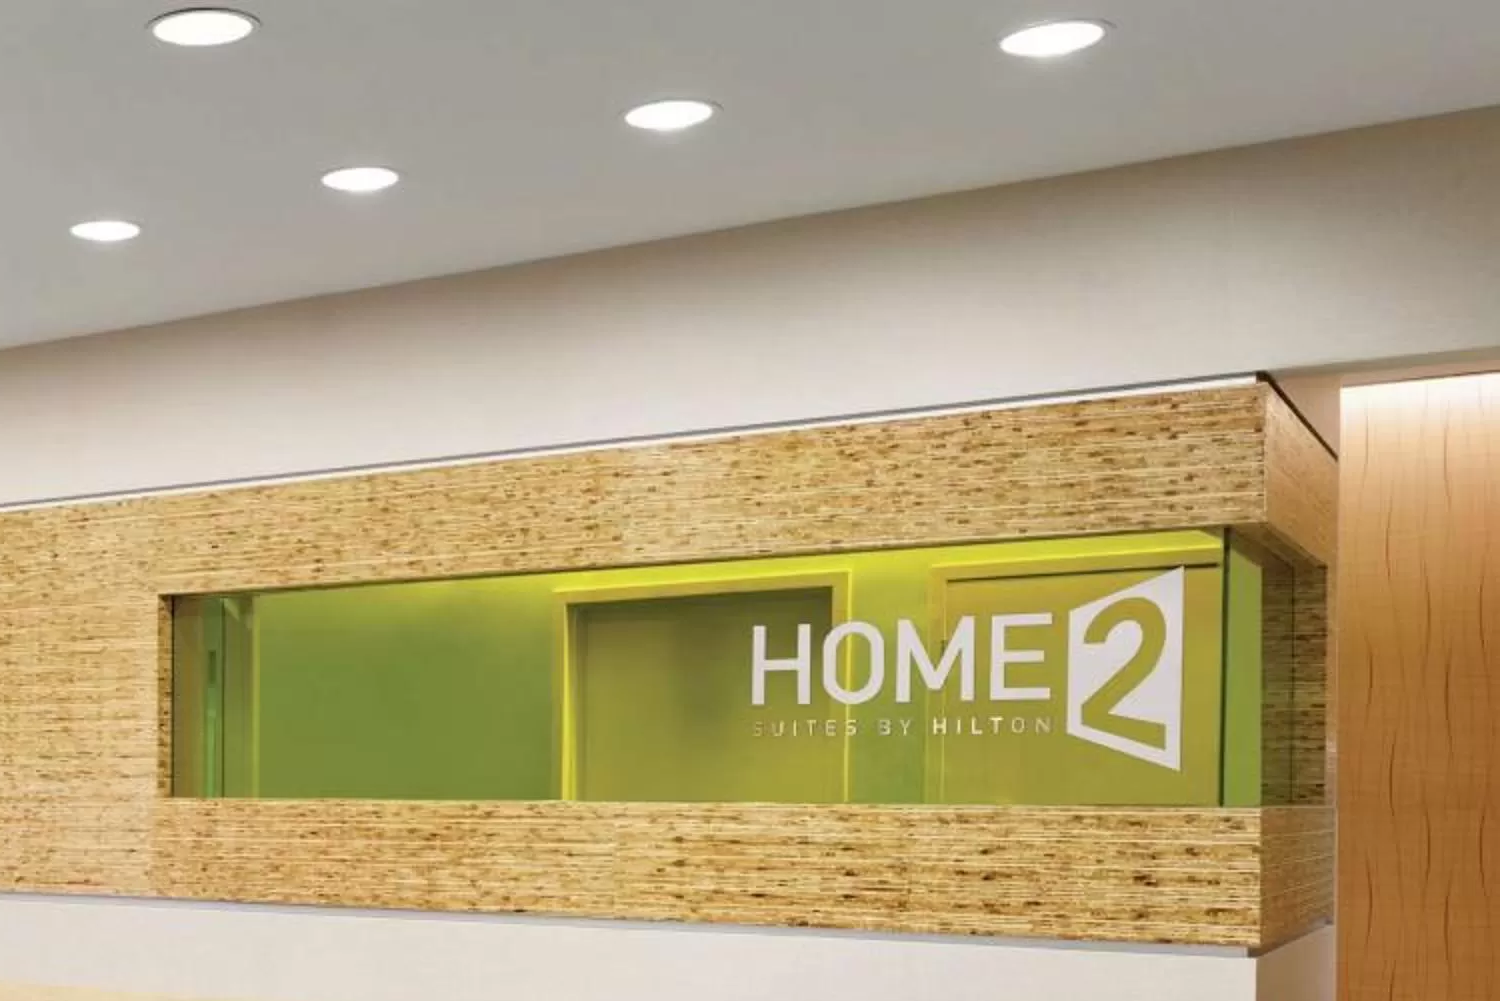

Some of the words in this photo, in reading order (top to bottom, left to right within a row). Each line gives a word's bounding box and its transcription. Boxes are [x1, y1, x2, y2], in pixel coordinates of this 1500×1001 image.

[752, 719, 857, 737] SUITES
[879, 718, 912, 736] BY
[932, 716, 1050, 735] HILTON
